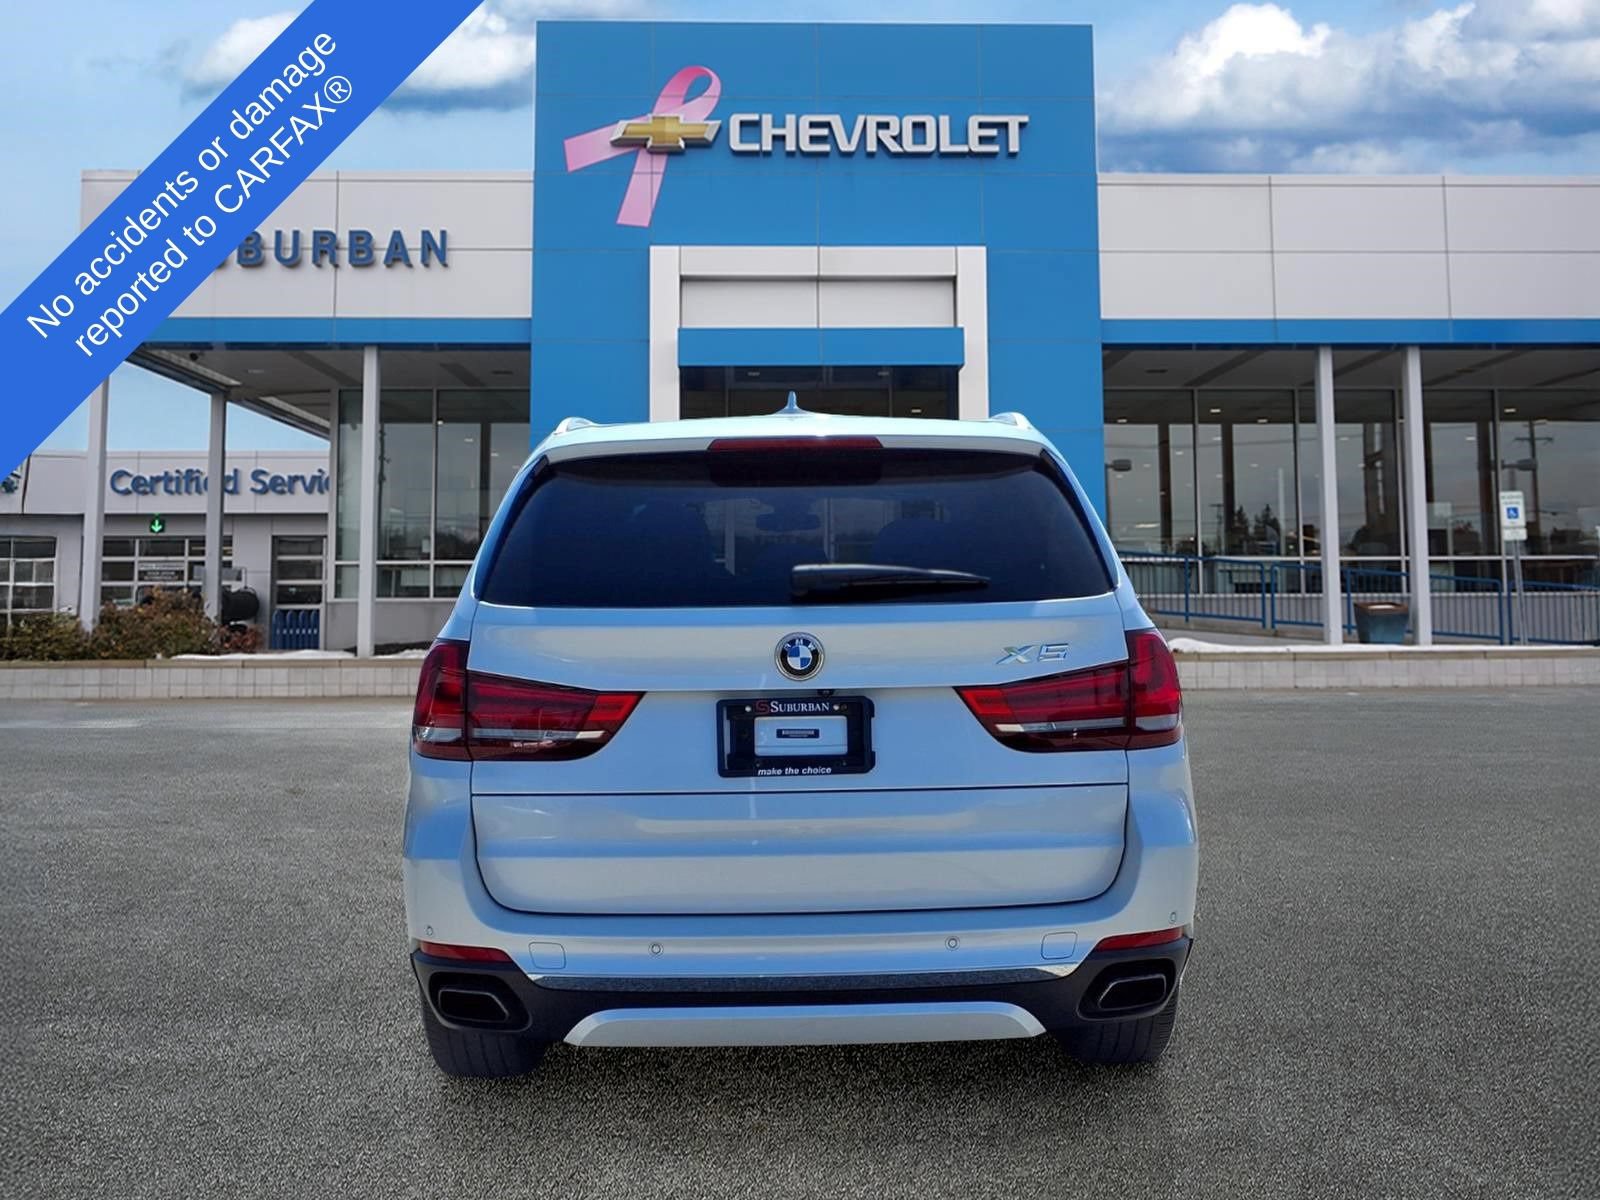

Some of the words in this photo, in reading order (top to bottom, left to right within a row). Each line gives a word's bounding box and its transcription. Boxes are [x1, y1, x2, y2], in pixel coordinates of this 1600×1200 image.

[729, 112, 1029, 153] CHEVROLET
[217, 229, 449, 268] BURBAN
[996, 643, 1069, 665] X5
[758, 766, 783, 776] make
[785, 767, 799, 775] the
[802, 766, 832, 775] choice
